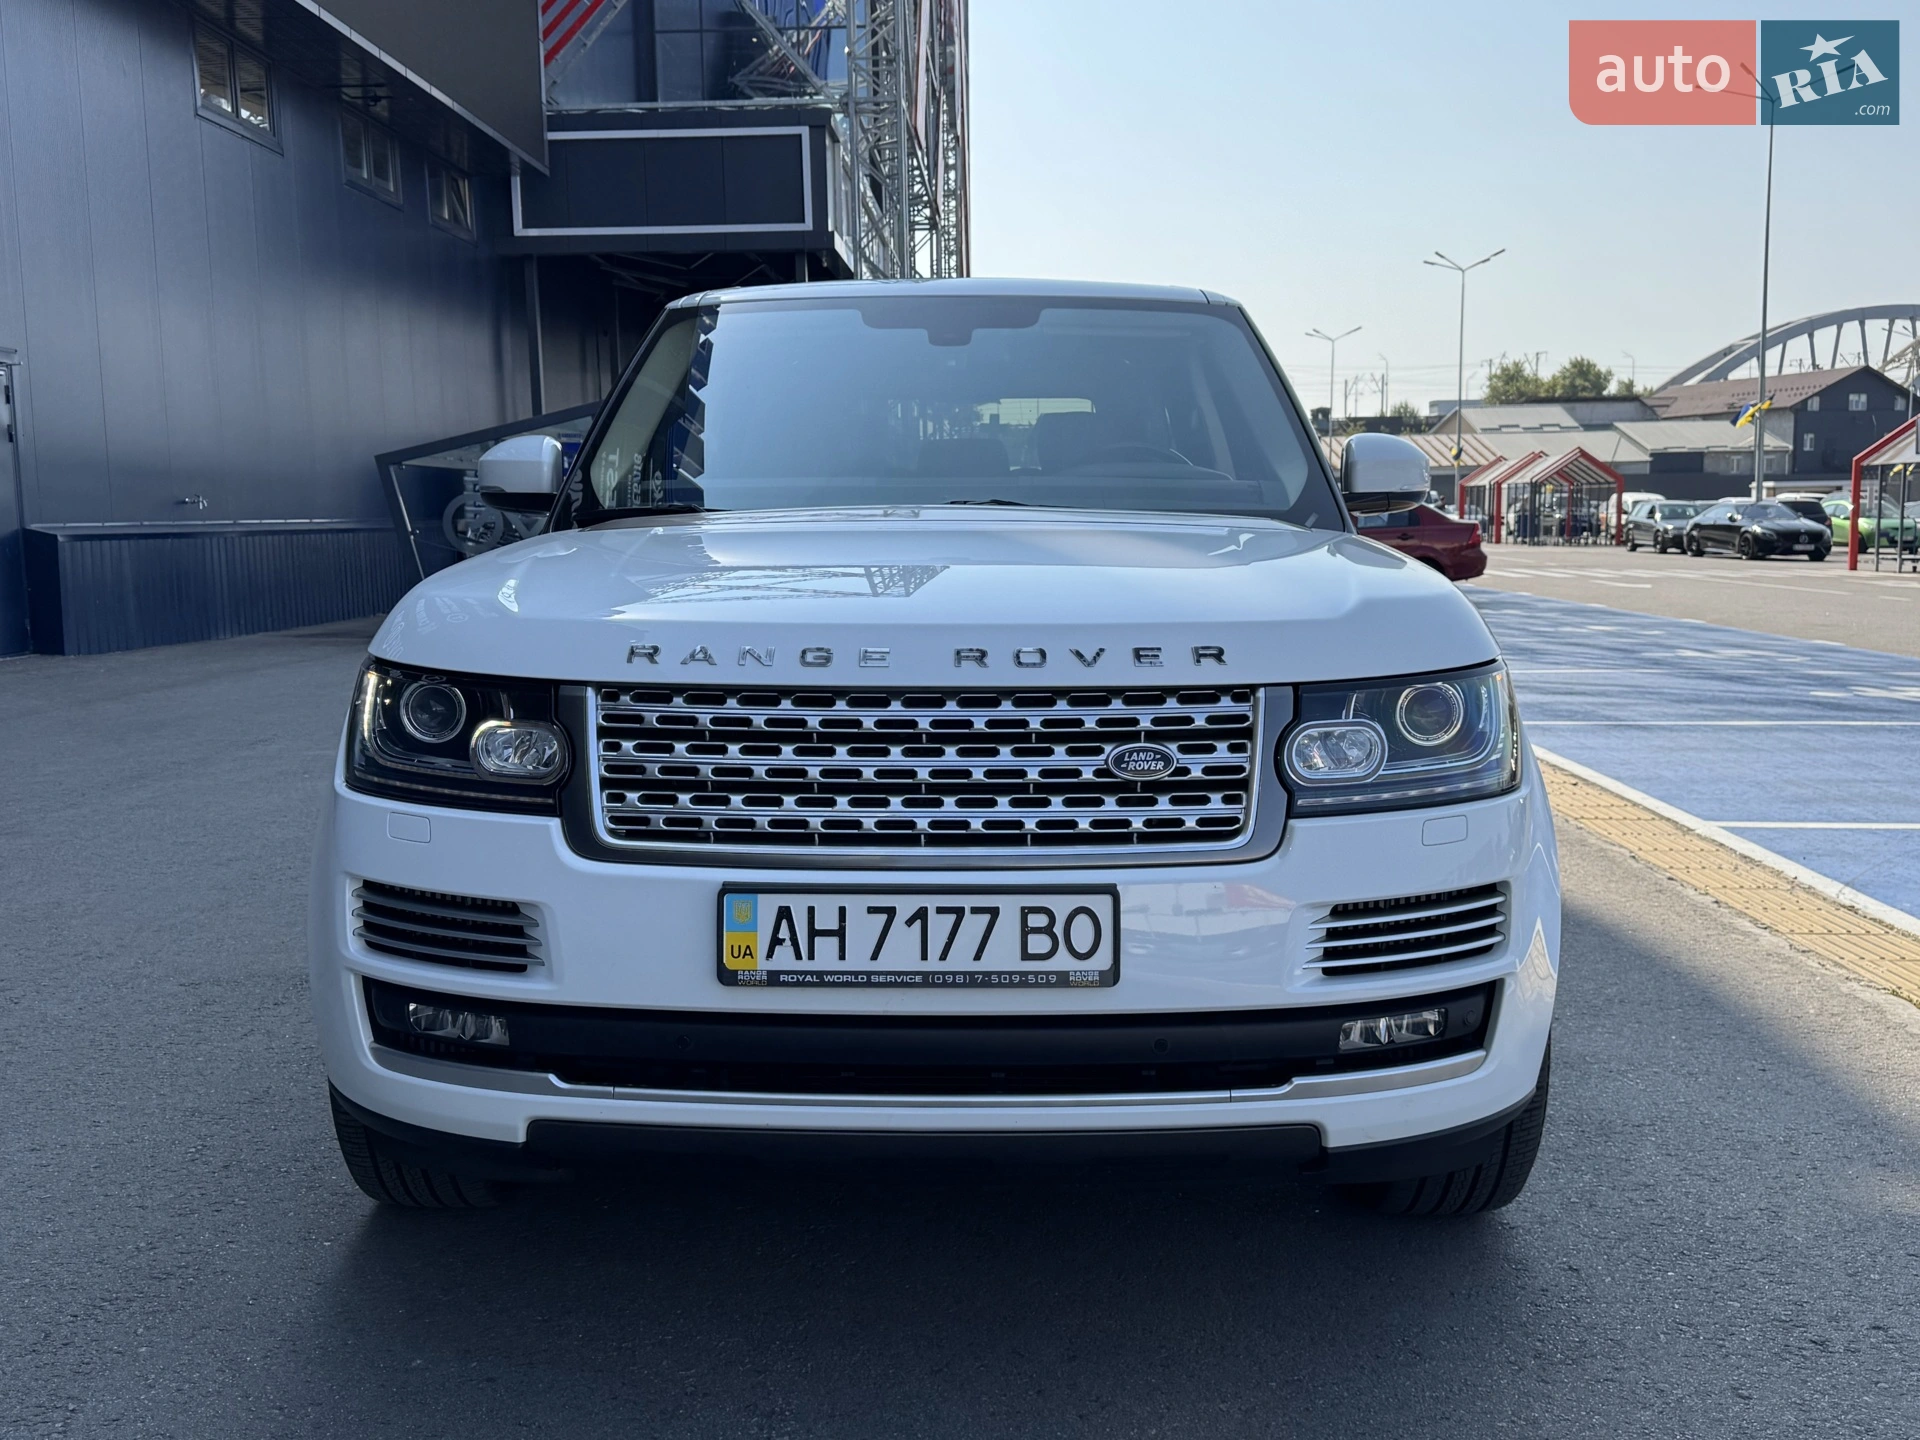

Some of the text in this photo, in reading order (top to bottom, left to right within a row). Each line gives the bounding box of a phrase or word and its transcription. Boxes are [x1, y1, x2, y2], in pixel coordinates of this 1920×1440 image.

[625, 643, 1229, 669] RANGE ROVER
[1123, 751, 1155, 762] LAND
[1127, 760, 1165, 771] ROVER
[765, 905, 847, 961] AH
[866, 905, 1000, 961] 7177
[730, 944, 755, 960] UA
[779, 974, 1057, 984] ROYAL WORLD SERVICE (098) 7-509-509
